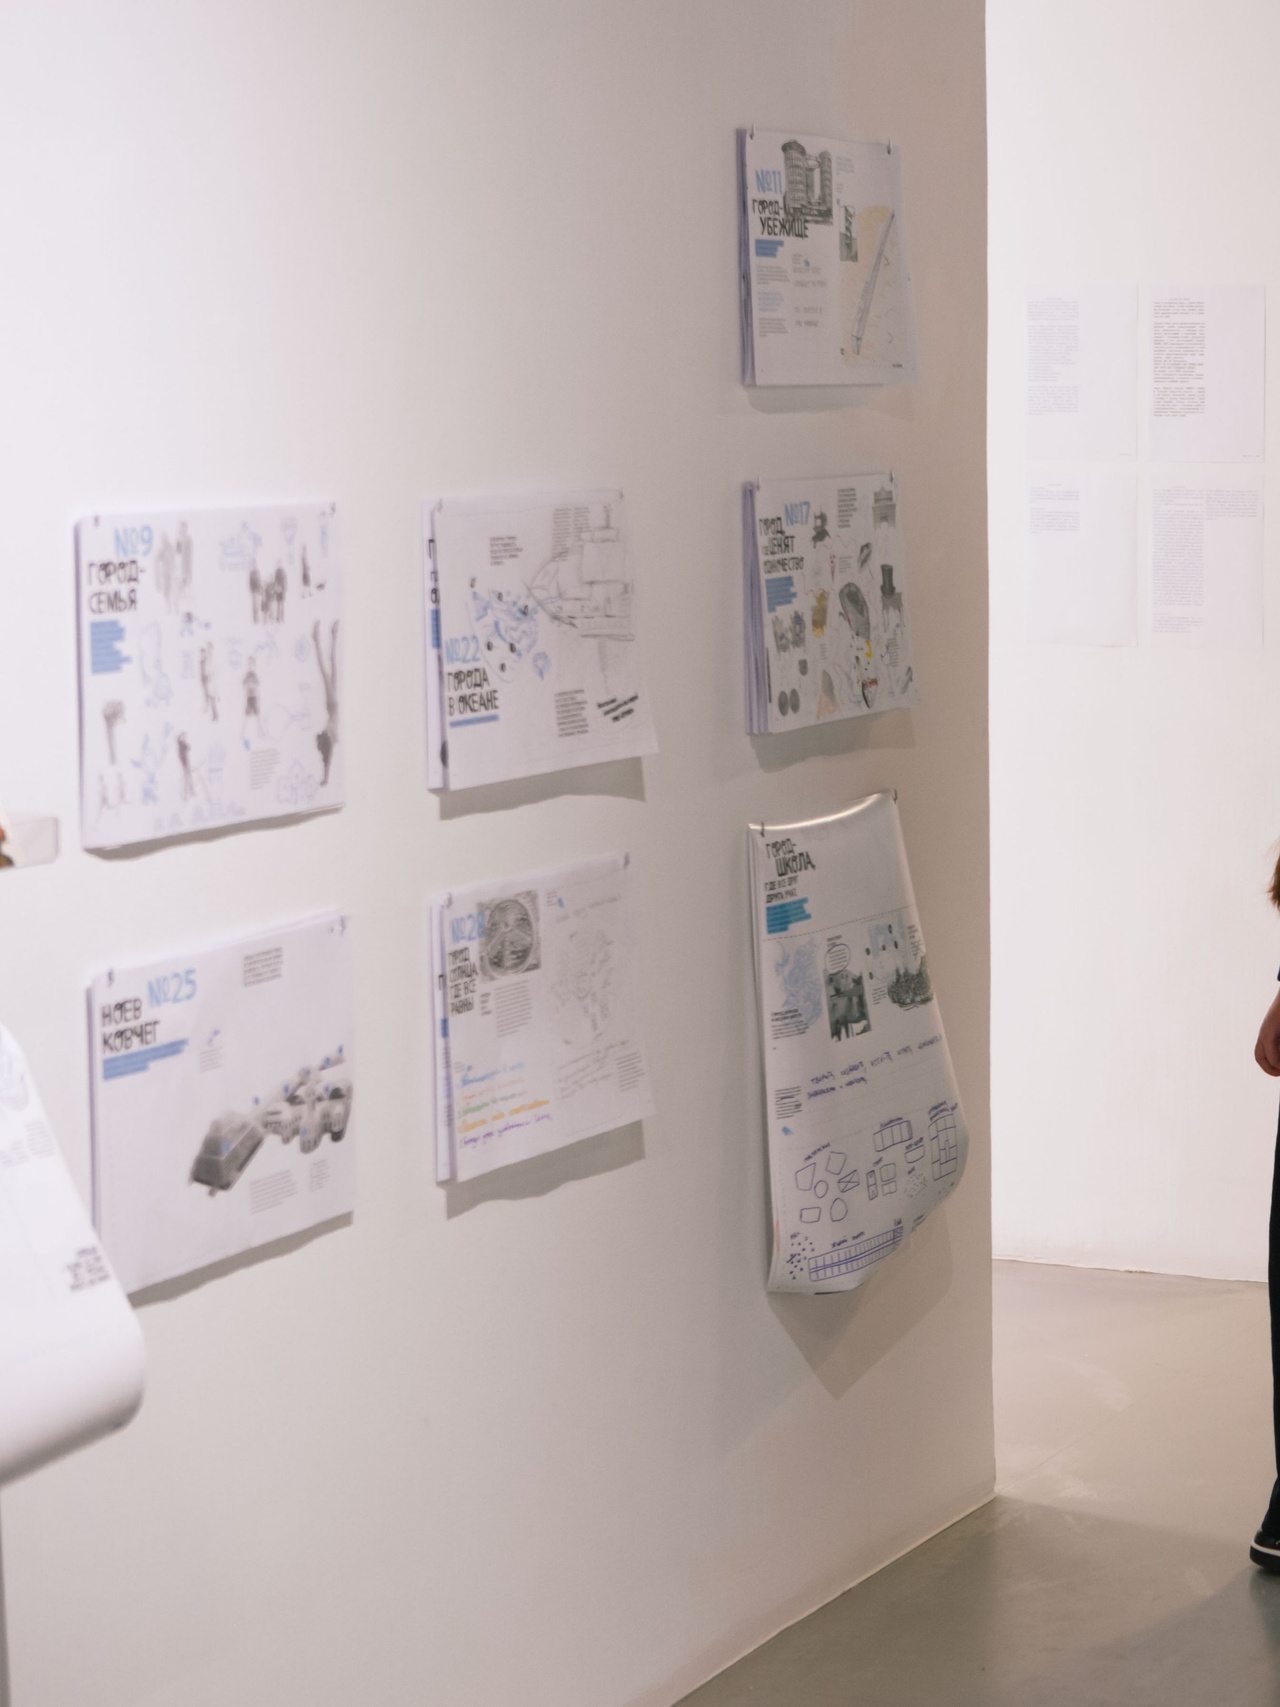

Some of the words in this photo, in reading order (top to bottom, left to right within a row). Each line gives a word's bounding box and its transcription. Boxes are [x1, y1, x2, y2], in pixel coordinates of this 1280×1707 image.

[755, 169, 783, 194] №11
[759, 216, 809, 240] УБЕЖИЩЕ
[784, 501, 811, 527] №17
[114, 525, 154, 559] №9
[88, 588, 138, 615] СЕМЬЯ
[445, 634, 481, 665] №22
[446, 667, 491, 693] ГОРОДА
[448, 696, 455, 717] В
[458, 689, 500, 716] ОКЕАНЕ
[147, 968, 198, 1009] №25
[463, 978, 477, 996] ВСЕ
[101, 998, 143, 1028] НОЕВ
[102, 1019, 161, 1054] КОВЧЕГ
